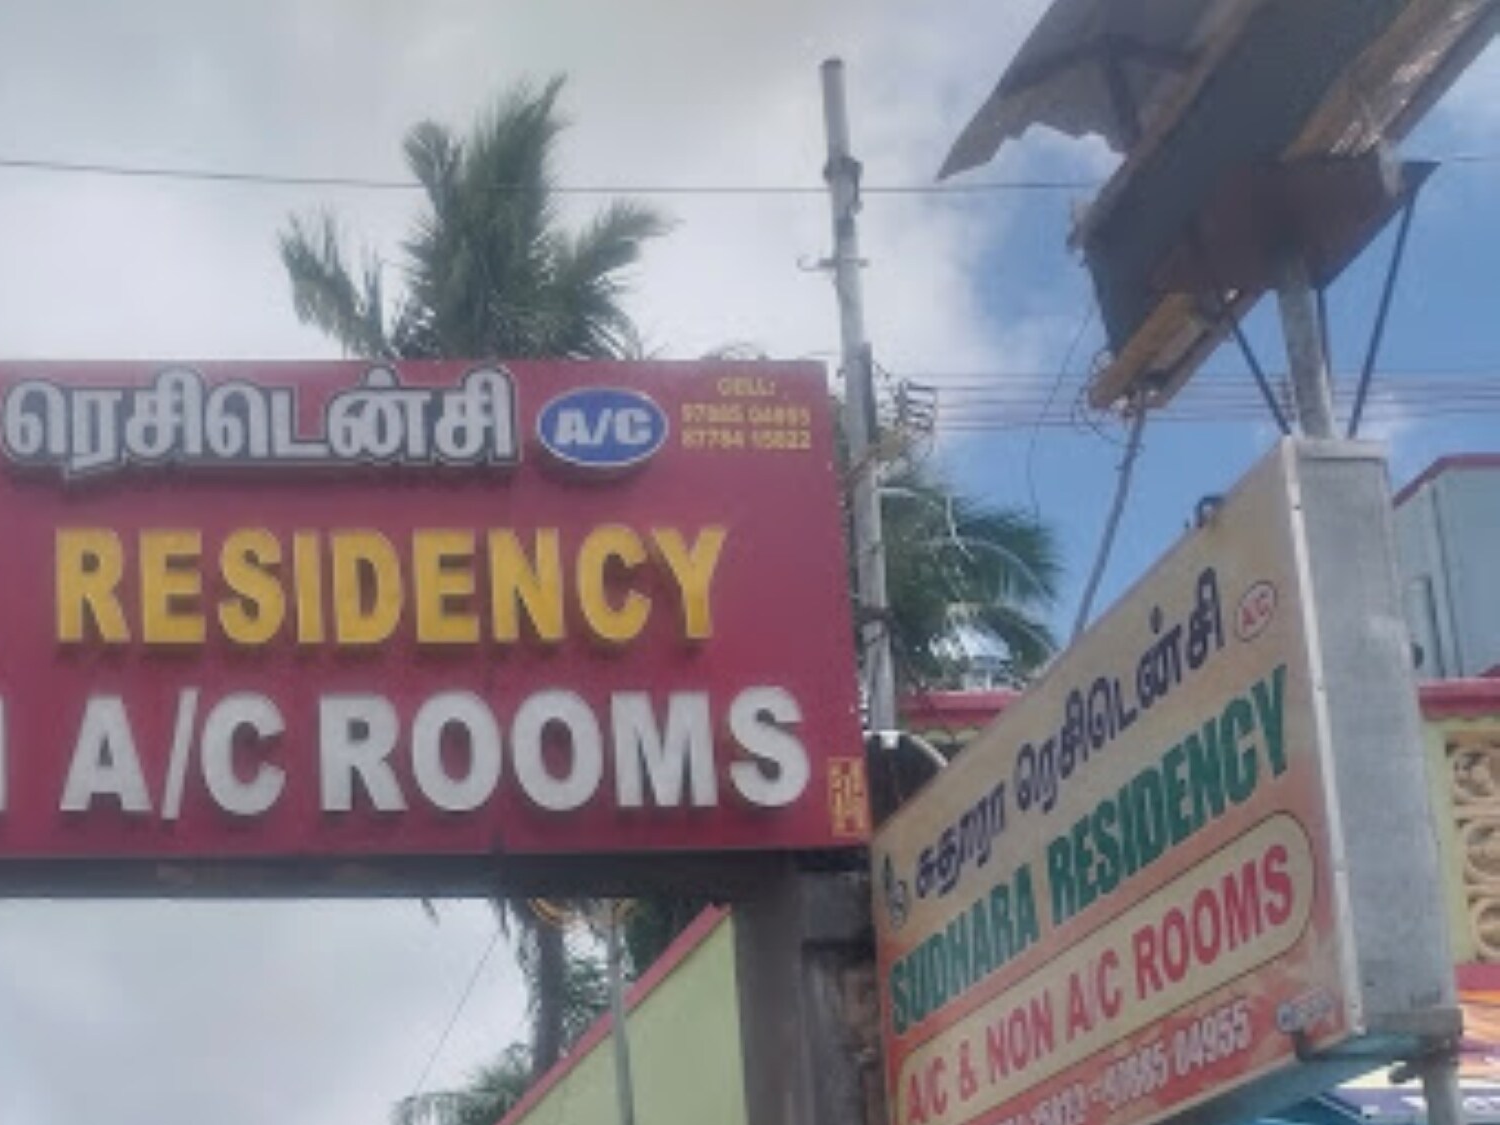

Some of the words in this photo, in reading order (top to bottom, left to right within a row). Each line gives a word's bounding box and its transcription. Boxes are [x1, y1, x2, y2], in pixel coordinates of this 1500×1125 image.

[1, 366, 518, 476] ரெசிடென்சி
[552, 408, 655, 448] A/C
[55, 525, 728, 646] RESIDENCY
[58, 686, 288, 822] A/C
[318, 686, 812, 814] ROOMS
[916, 780, 1007, 898] சுதாரா
[1014, 566, 1225, 814] ரெசிடென்சி
[890, 862, 1041, 1036] SUDHARA
[1046, 664, 1288, 925] RESIDENCY
[958, 1040, 979, 1101] &
[986, 989, 1056, 1086] NON
[1065, 949, 1122, 1043] A/C
[1131, 843, 1294, 1001] ROOMS
